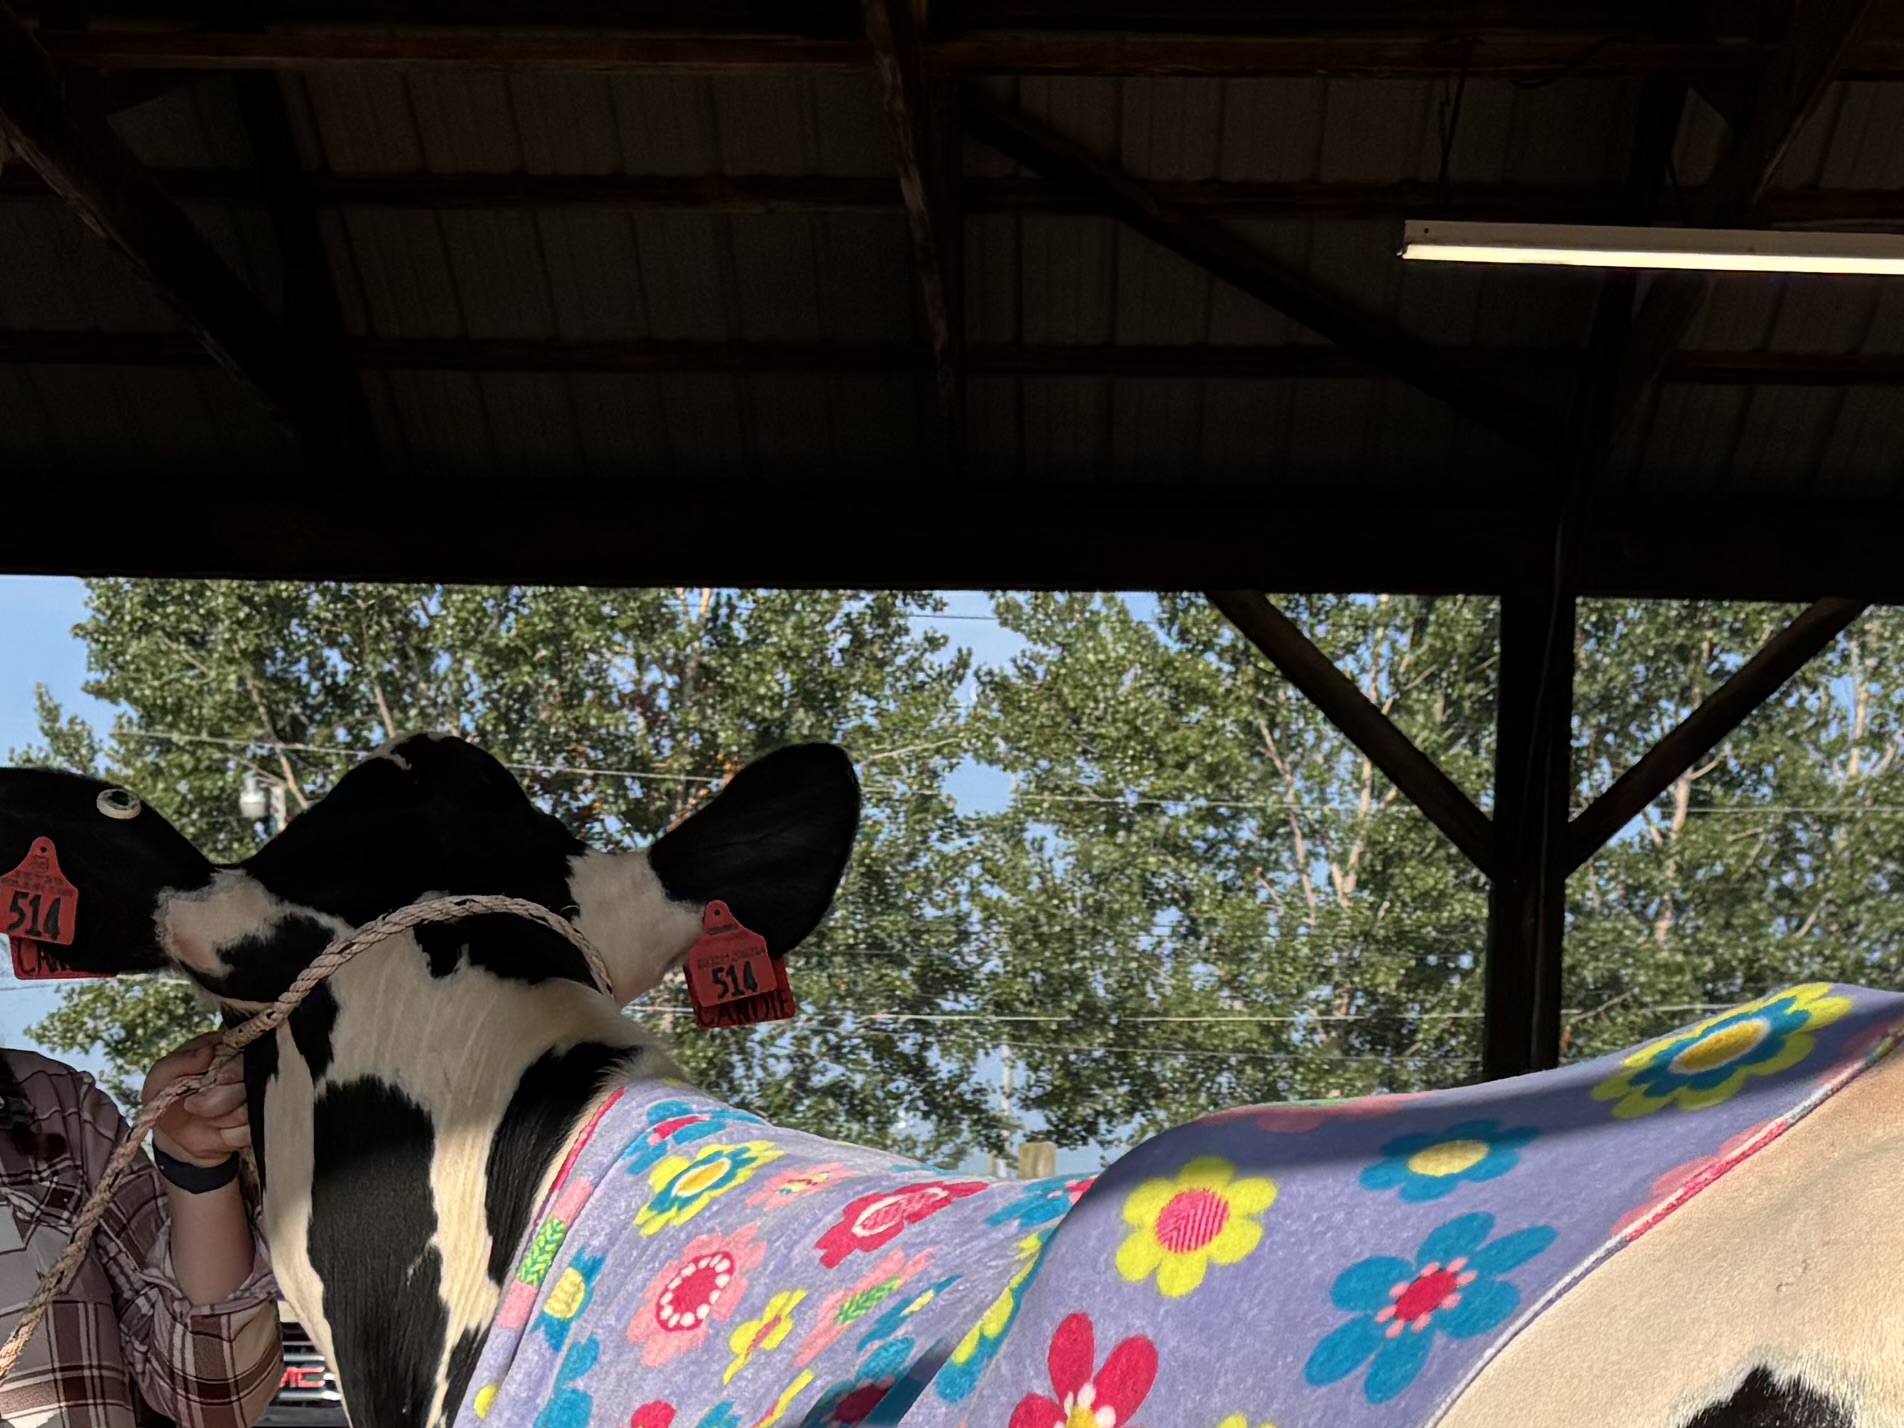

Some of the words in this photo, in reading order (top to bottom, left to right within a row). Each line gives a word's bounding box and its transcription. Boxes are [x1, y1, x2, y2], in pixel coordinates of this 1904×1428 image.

[7, 890, 62, 941] 514
[711, 960, 760, 1000] 514
[279, 1366, 326, 1388] MC
